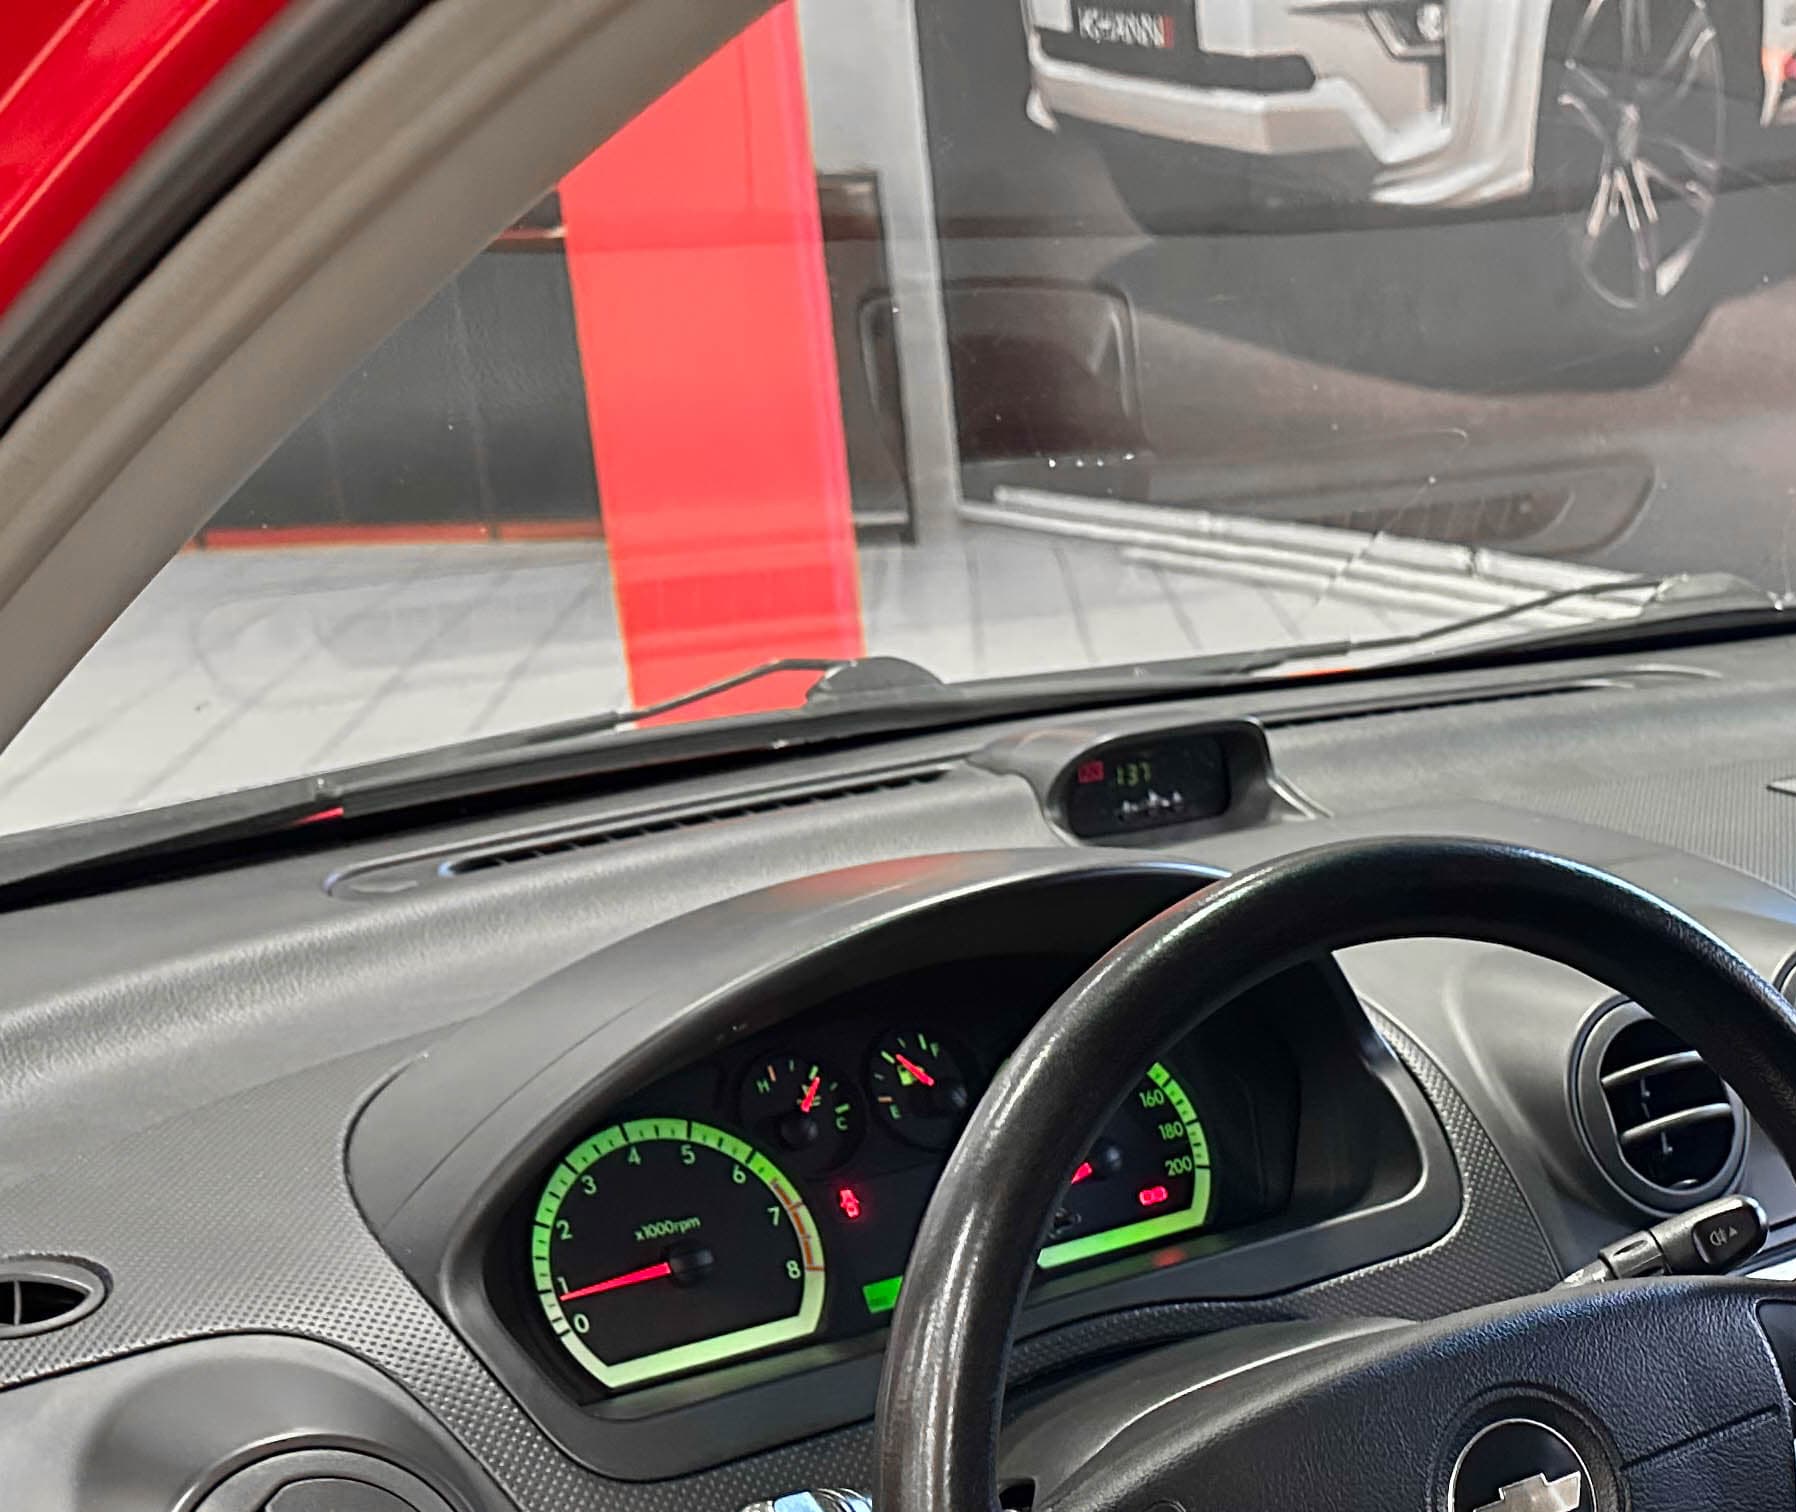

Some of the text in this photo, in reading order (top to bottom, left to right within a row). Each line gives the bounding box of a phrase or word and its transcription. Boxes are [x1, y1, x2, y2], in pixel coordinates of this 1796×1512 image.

[756, 1079, 770, 1094] H
[1139, 1090, 1164, 1108] 160
[836, 1117, 848, 1130] C
[1159, 1121, 1183, 1139] 180
[628, 1147, 641, 1165] 4
[681, 1145, 695, 1164] 5
[733, 1165, 746, 1183] 6
[1165, 1156, 1192, 1175] 200
[581, 1176, 597, 1195] 3
[768, 1207, 781, 1225] 7
[557, 1220, 573, 1240] 2
[786, 1260, 800, 1279] 8
[557, 1277, 568, 1295] 1
[573, 1314, 589, 1333] 0
